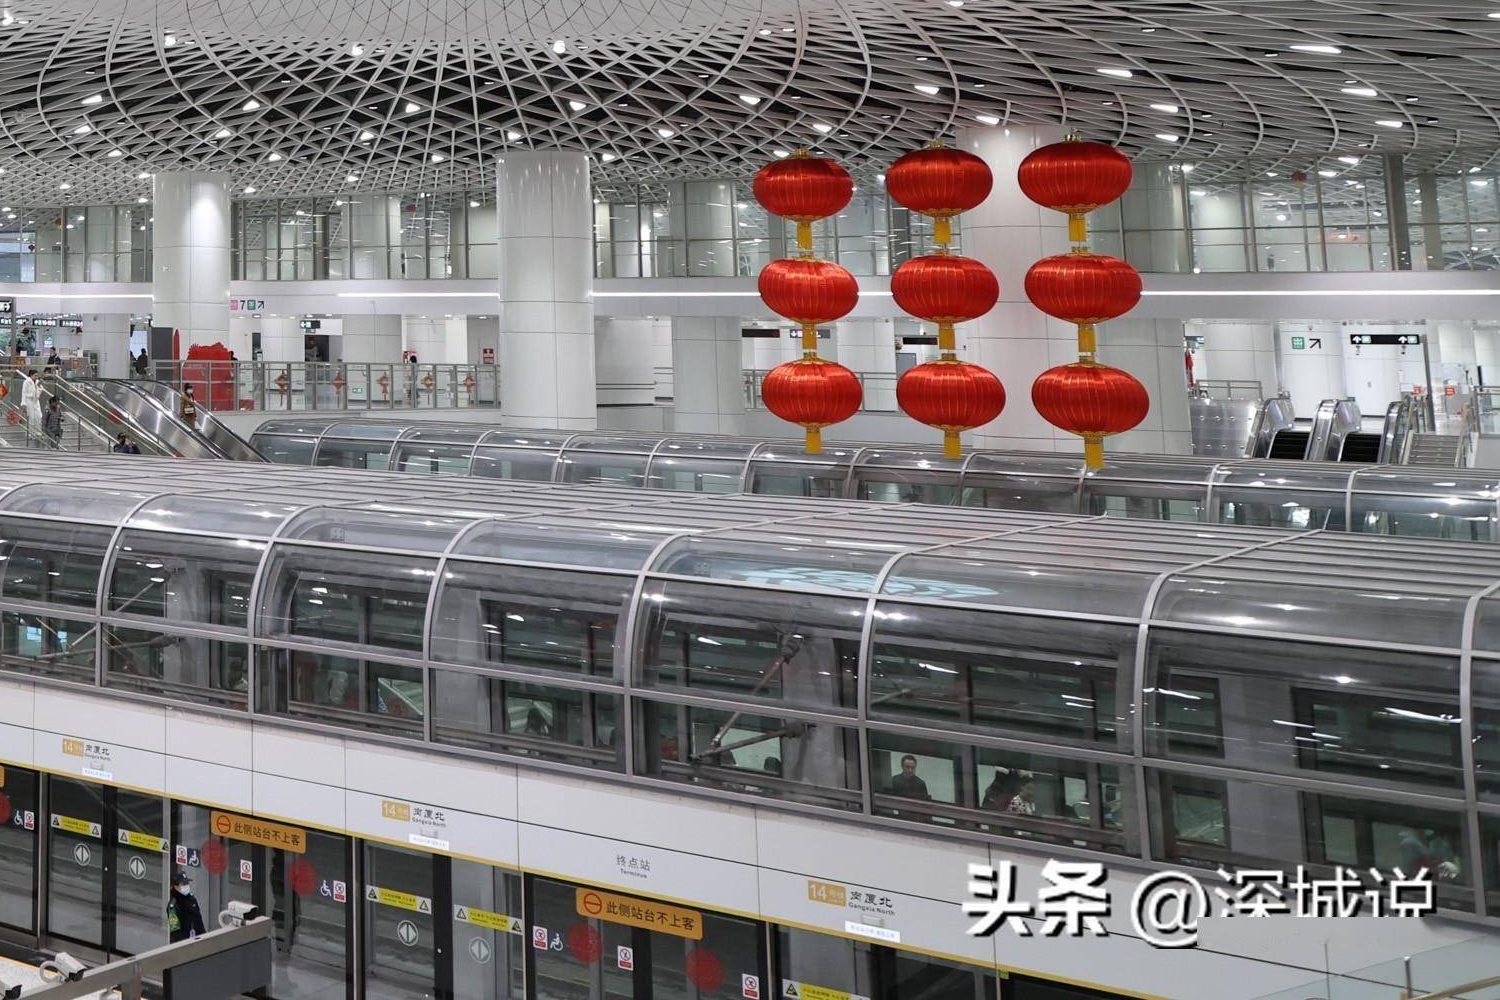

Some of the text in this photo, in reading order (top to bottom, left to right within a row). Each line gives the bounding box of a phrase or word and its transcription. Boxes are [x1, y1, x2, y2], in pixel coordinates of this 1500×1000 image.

[233, 822, 301, 847] 此侧站台不上客
[616, 854, 651, 872] 终点站
[848, 901, 896, 916] Gangxia North
[850, 891, 894, 909] 岗厦北
[605, 901, 695, 931] 此侧站台不上客
